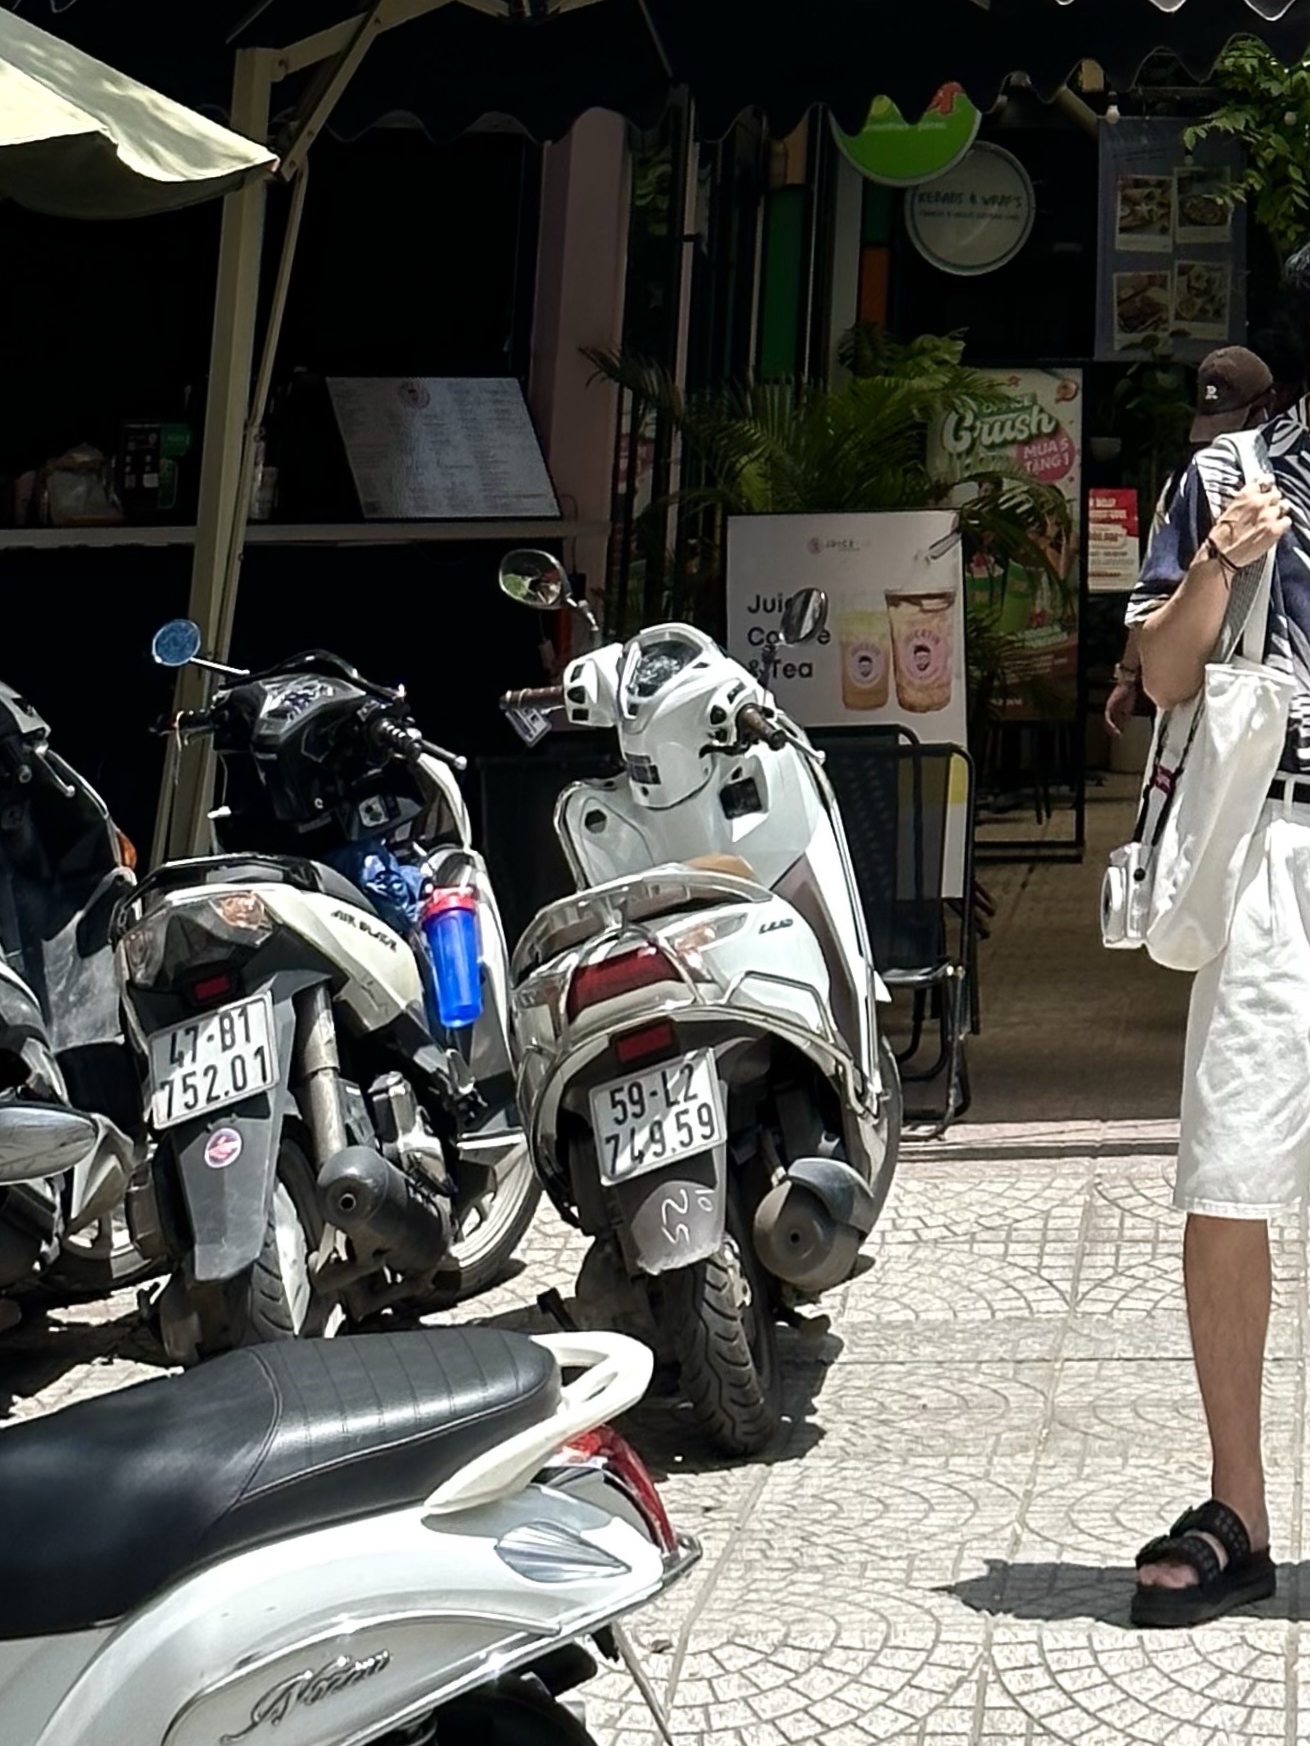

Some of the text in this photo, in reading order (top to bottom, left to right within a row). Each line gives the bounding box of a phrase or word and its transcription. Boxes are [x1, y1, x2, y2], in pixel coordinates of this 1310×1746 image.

[1024, 440, 1058, 459] MUA
[771, 659, 814, 679] Tea
[169, 1004, 251, 1068] 47-B1
[160, 1045, 268, 1121] 752.01
[609, 1063, 699, 1127] 59-L2
[604, 1102, 716, 1178] 749.59
